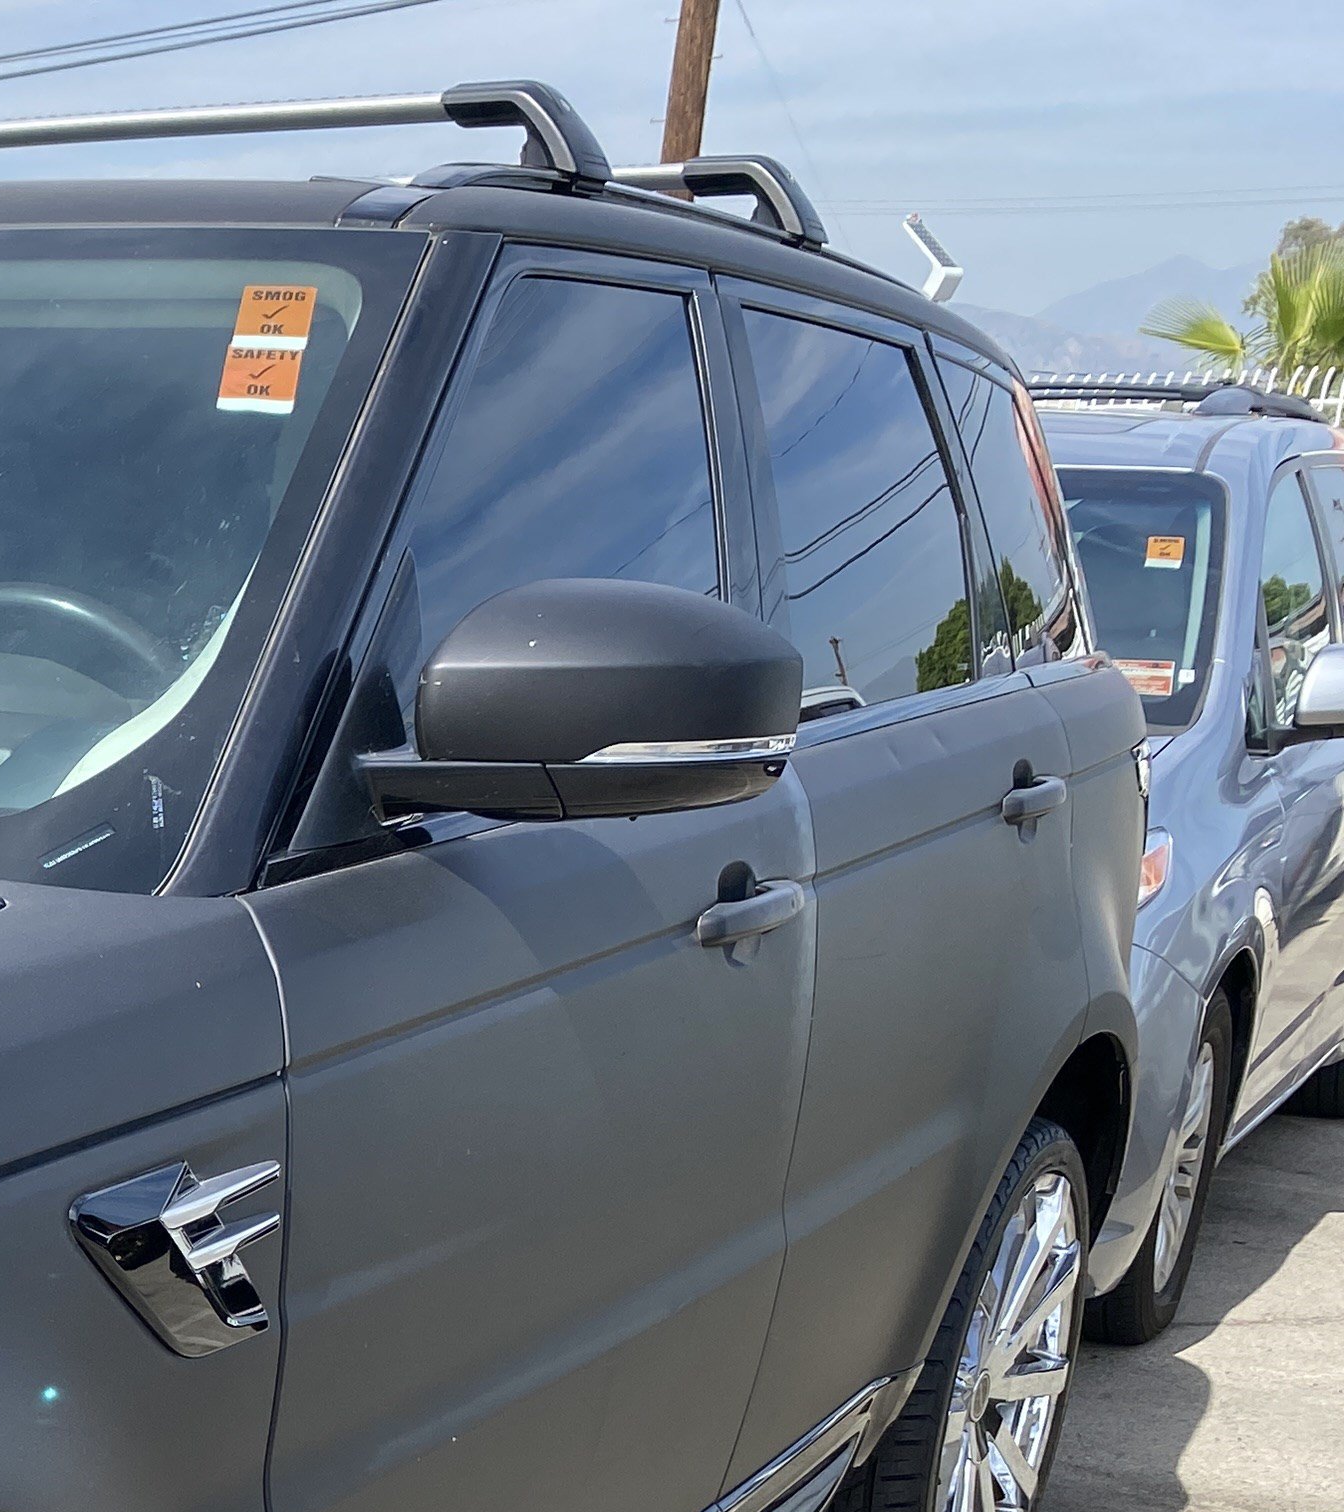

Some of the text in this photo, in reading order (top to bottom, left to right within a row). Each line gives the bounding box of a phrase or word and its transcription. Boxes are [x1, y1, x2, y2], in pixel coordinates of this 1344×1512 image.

[252, 290, 306, 301] SMOG
[260, 324, 284, 335] OK
[232, 348, 300, 361] SAFETY
[246, 384, 271, 396] OK
